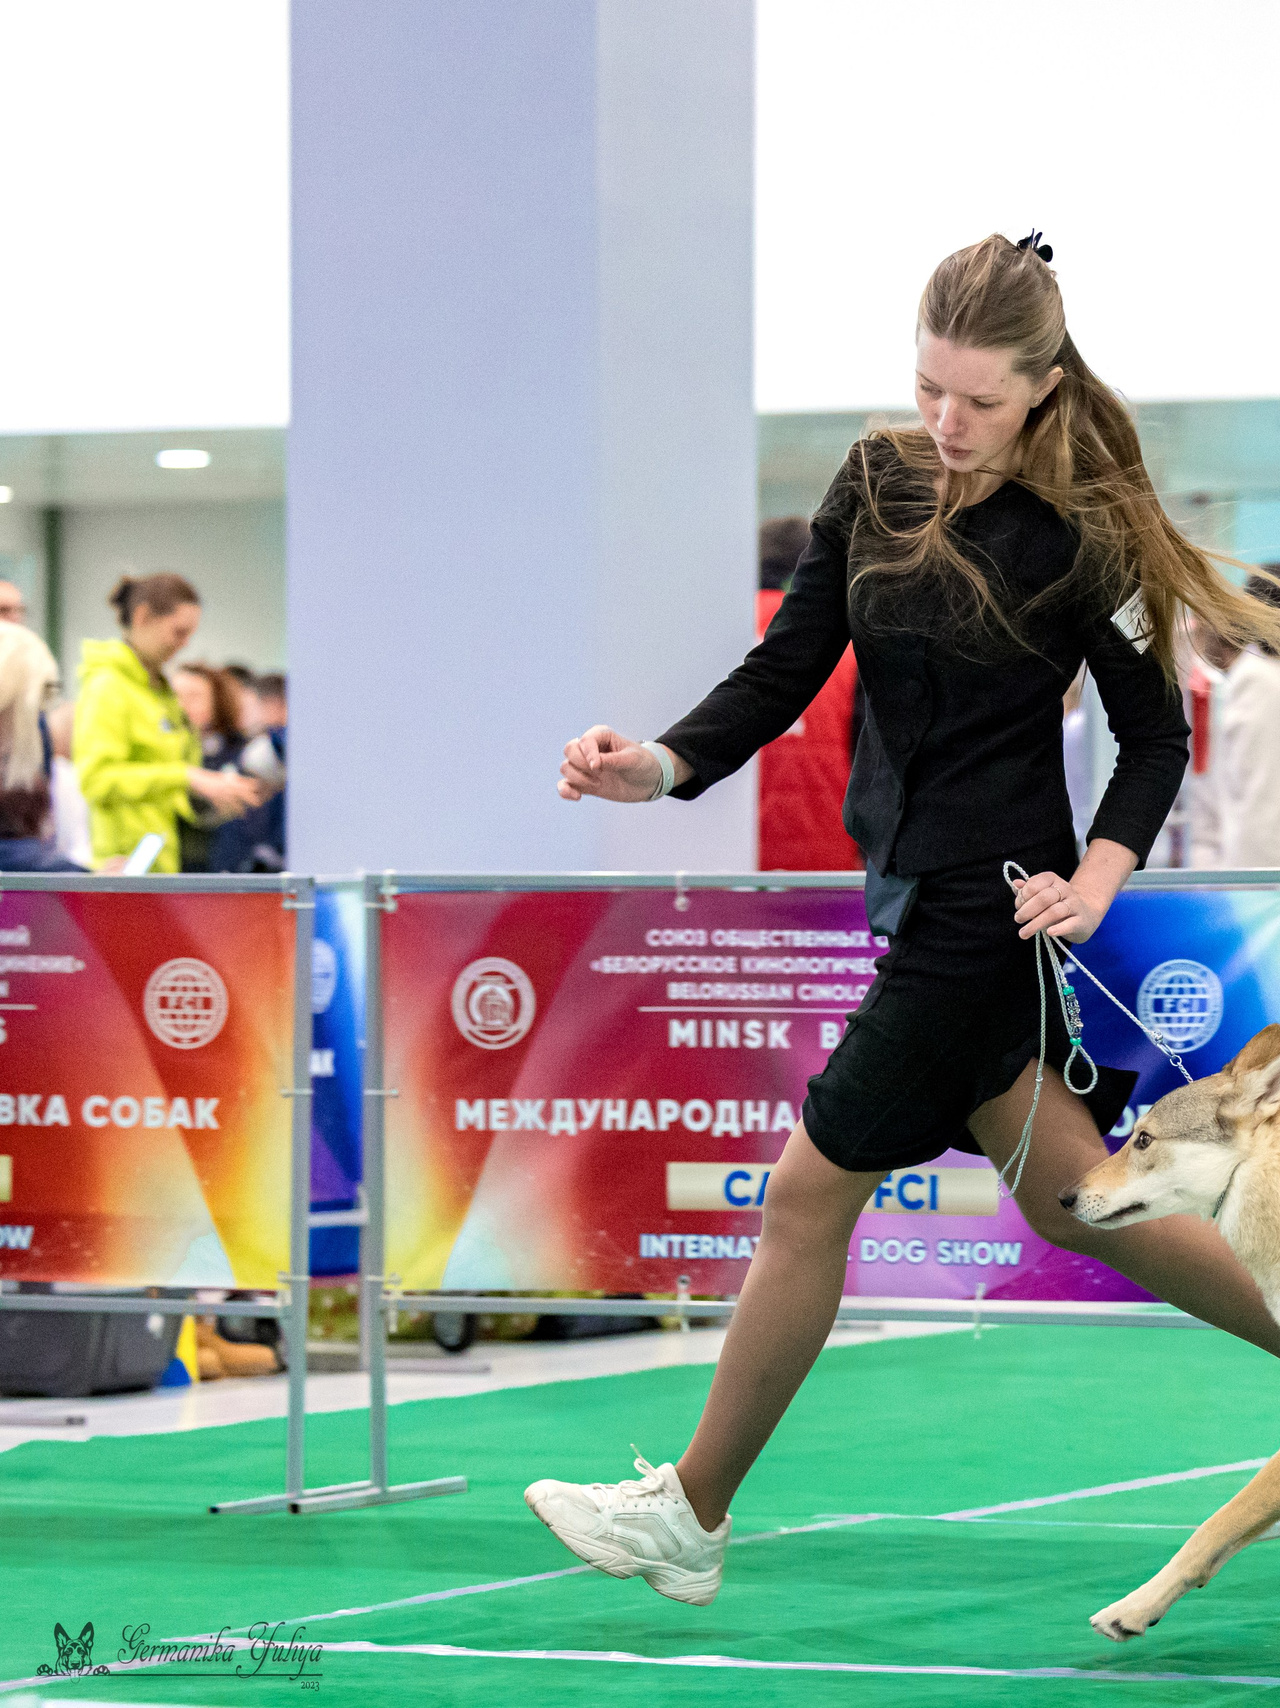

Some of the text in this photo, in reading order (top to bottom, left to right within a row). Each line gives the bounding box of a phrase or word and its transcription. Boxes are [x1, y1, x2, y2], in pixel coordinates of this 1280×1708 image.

[646, 929, 708, 948] СОЮЗ
[668, 1019, 791, 1049] MINSK
[82, 1095, 219, 1129] СОБАК
[639, 1234, 1022, 1266] INTERNA DOG SHOW
